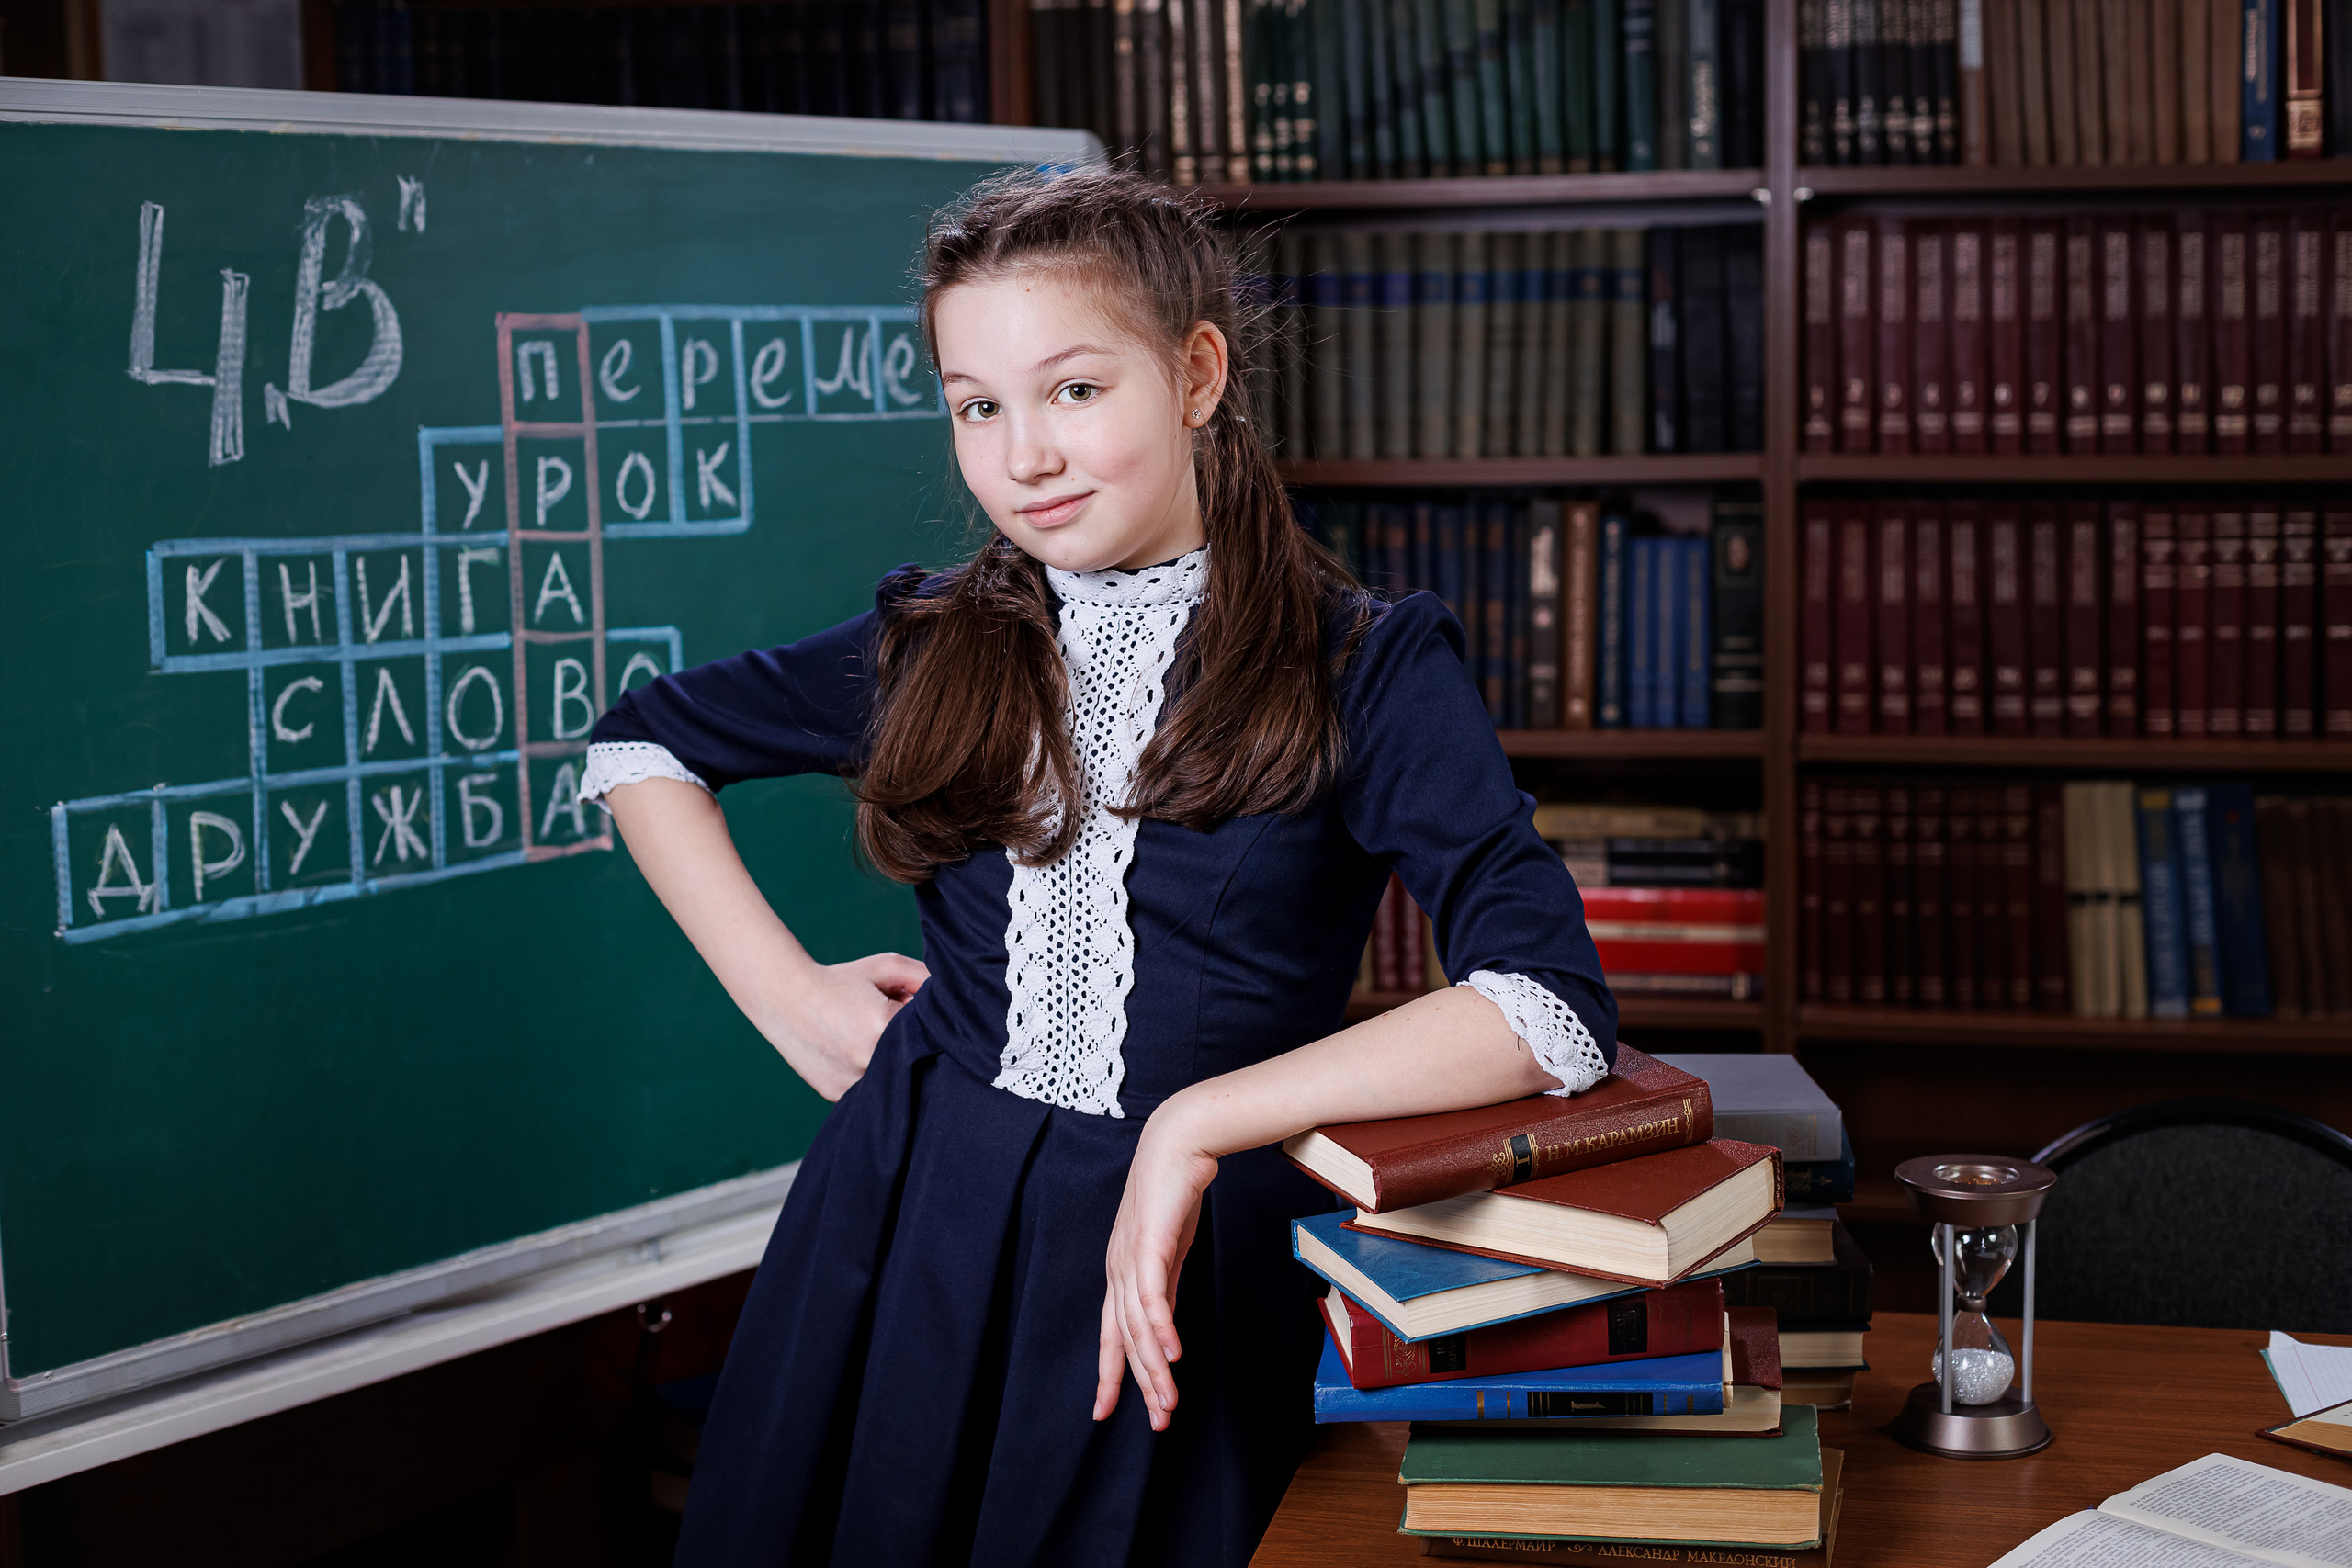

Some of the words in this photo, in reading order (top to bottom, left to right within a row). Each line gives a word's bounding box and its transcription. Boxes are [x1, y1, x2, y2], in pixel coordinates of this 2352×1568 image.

[186, 547, 584, 644] КНИГА
[87, 762, 586, 918] ДРУЖБА
[1598, 1545, 1680, 1562] АЛЕКСАНДР
